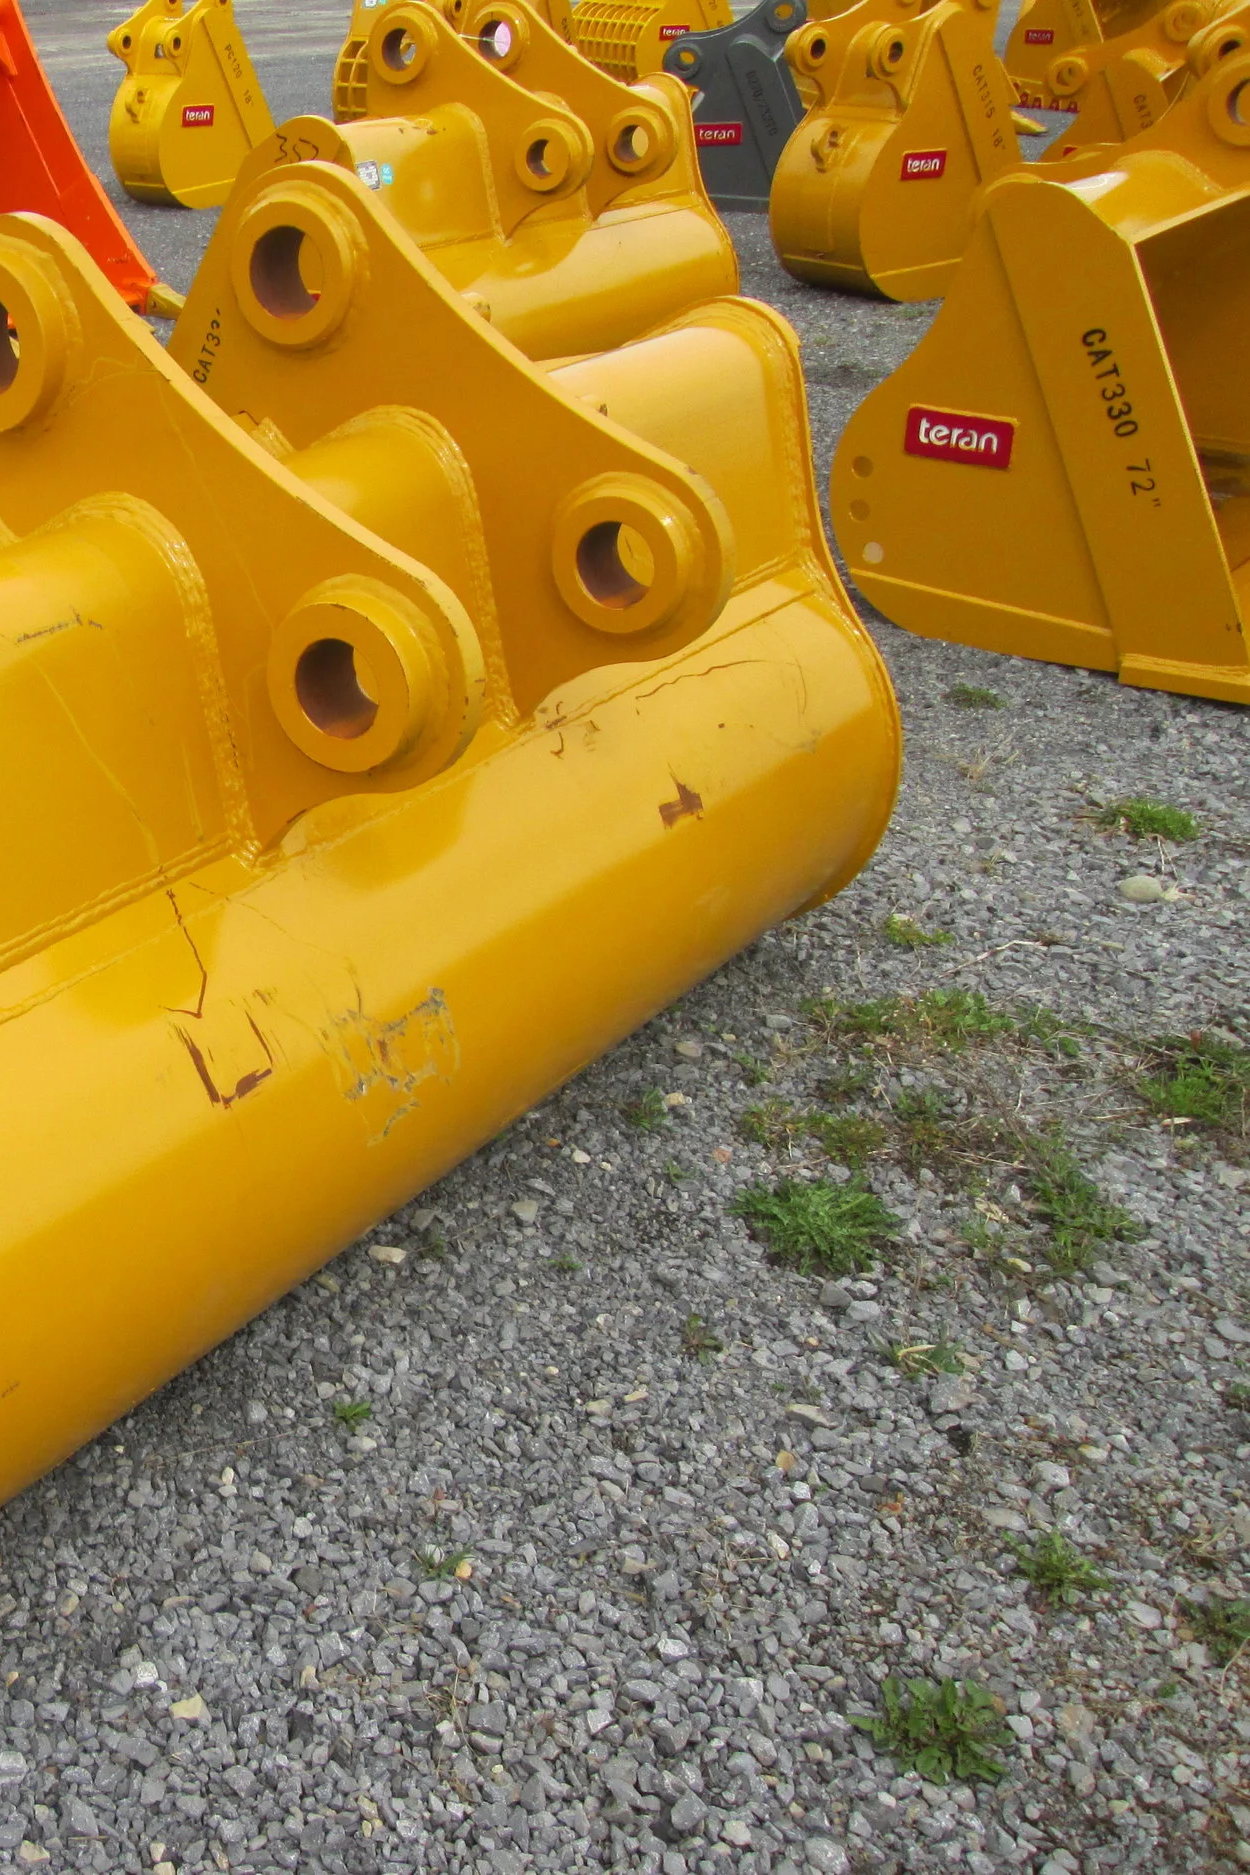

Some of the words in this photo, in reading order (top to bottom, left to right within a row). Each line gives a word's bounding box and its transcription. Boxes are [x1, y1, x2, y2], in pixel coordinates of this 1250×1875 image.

[185, 109, 211, 121] teran
[699, 128, 736, 140] teran
[907, 157, 940, 173] teran
[1081, 328, 1139, 439] CAT330
[1125, 458, 1162, 508] 72"
[918, 417, 999, 454] teran
